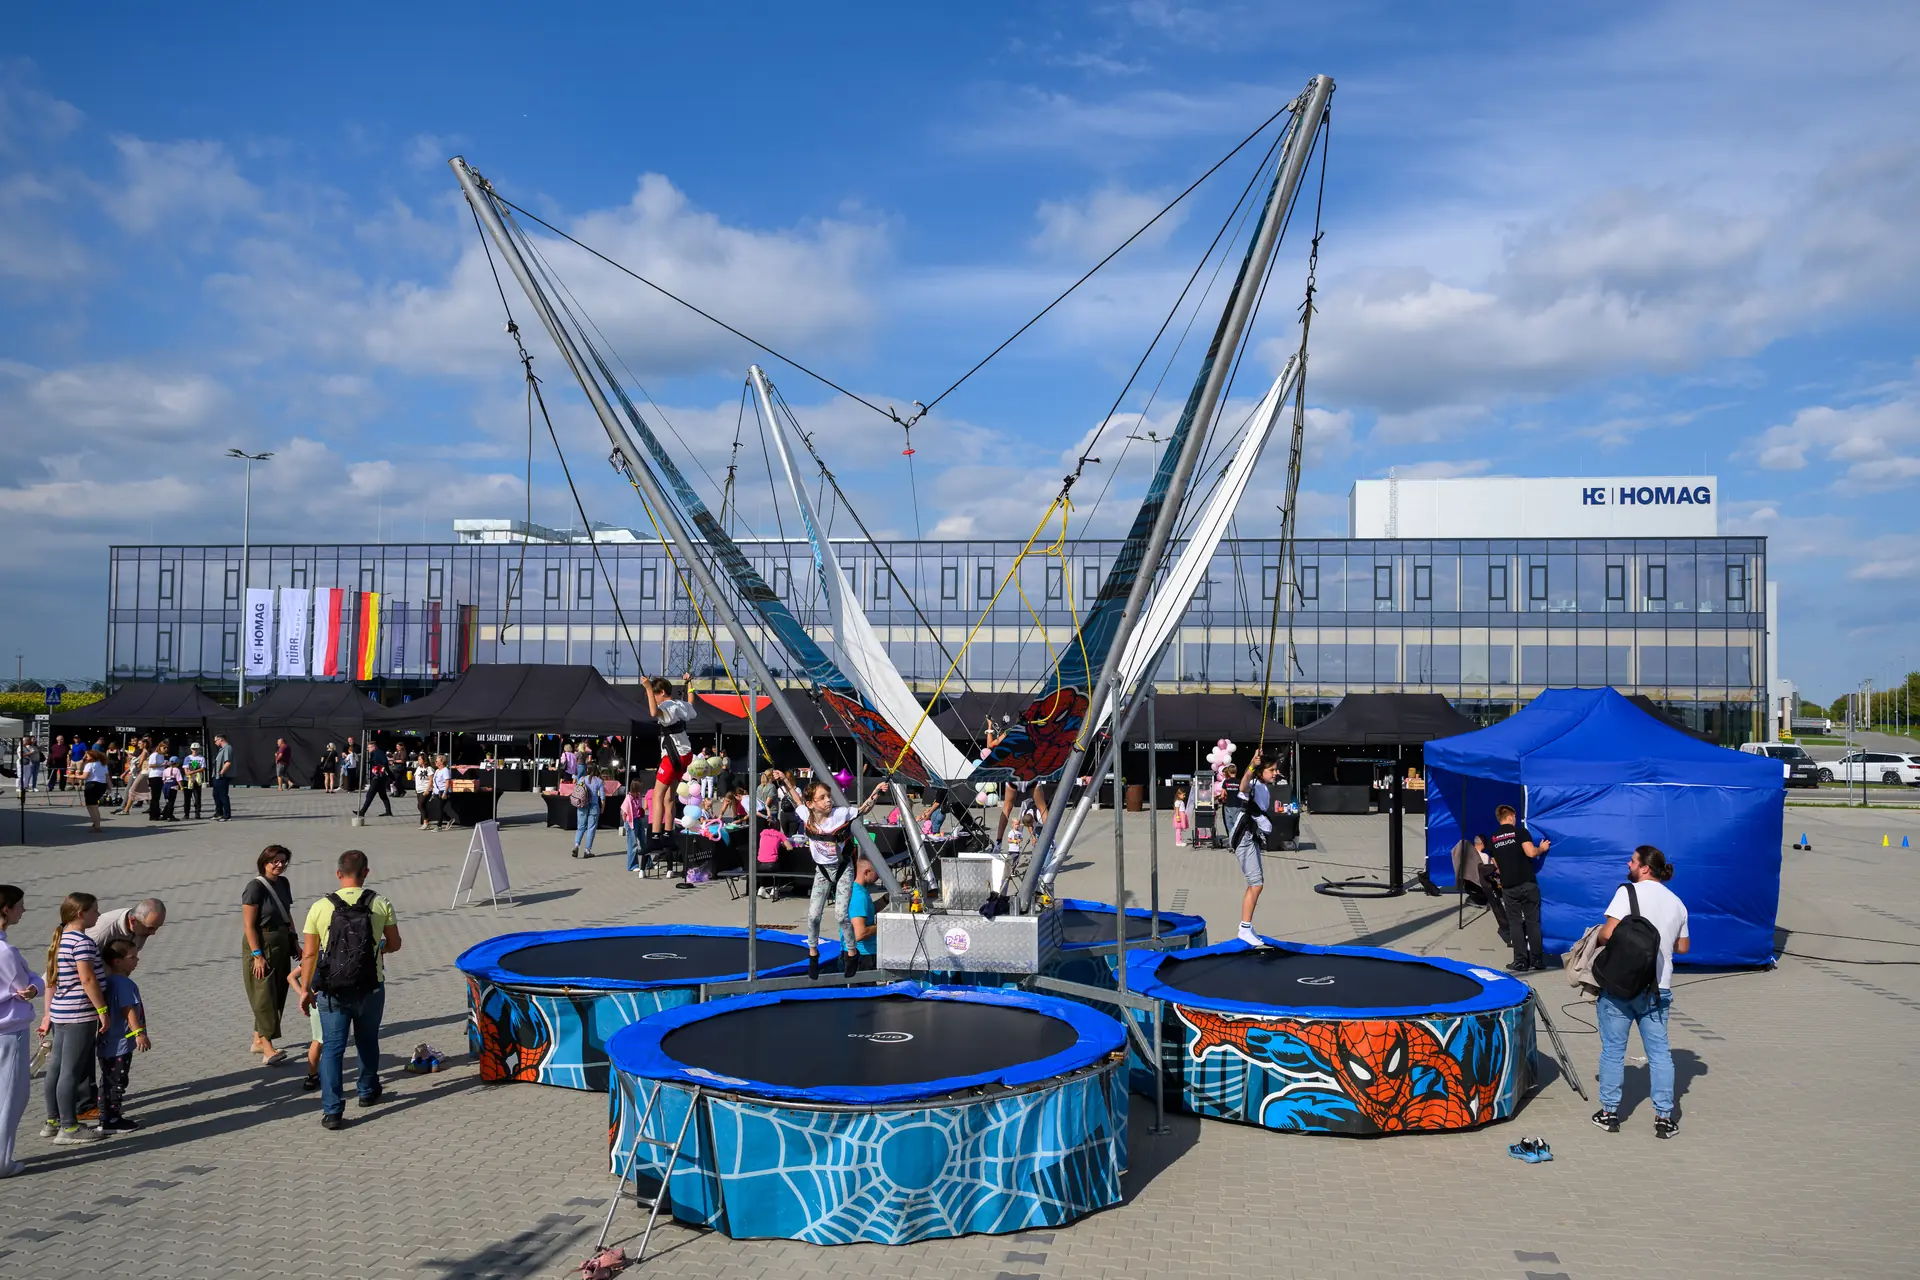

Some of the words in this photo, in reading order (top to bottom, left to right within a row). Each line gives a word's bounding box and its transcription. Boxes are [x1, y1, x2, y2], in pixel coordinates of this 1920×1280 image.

[1620, 486, 1711, 505] HOMAG
[254, 603, 265, 646] HOMAG
[286, 638, 299, 664] DÜRR
